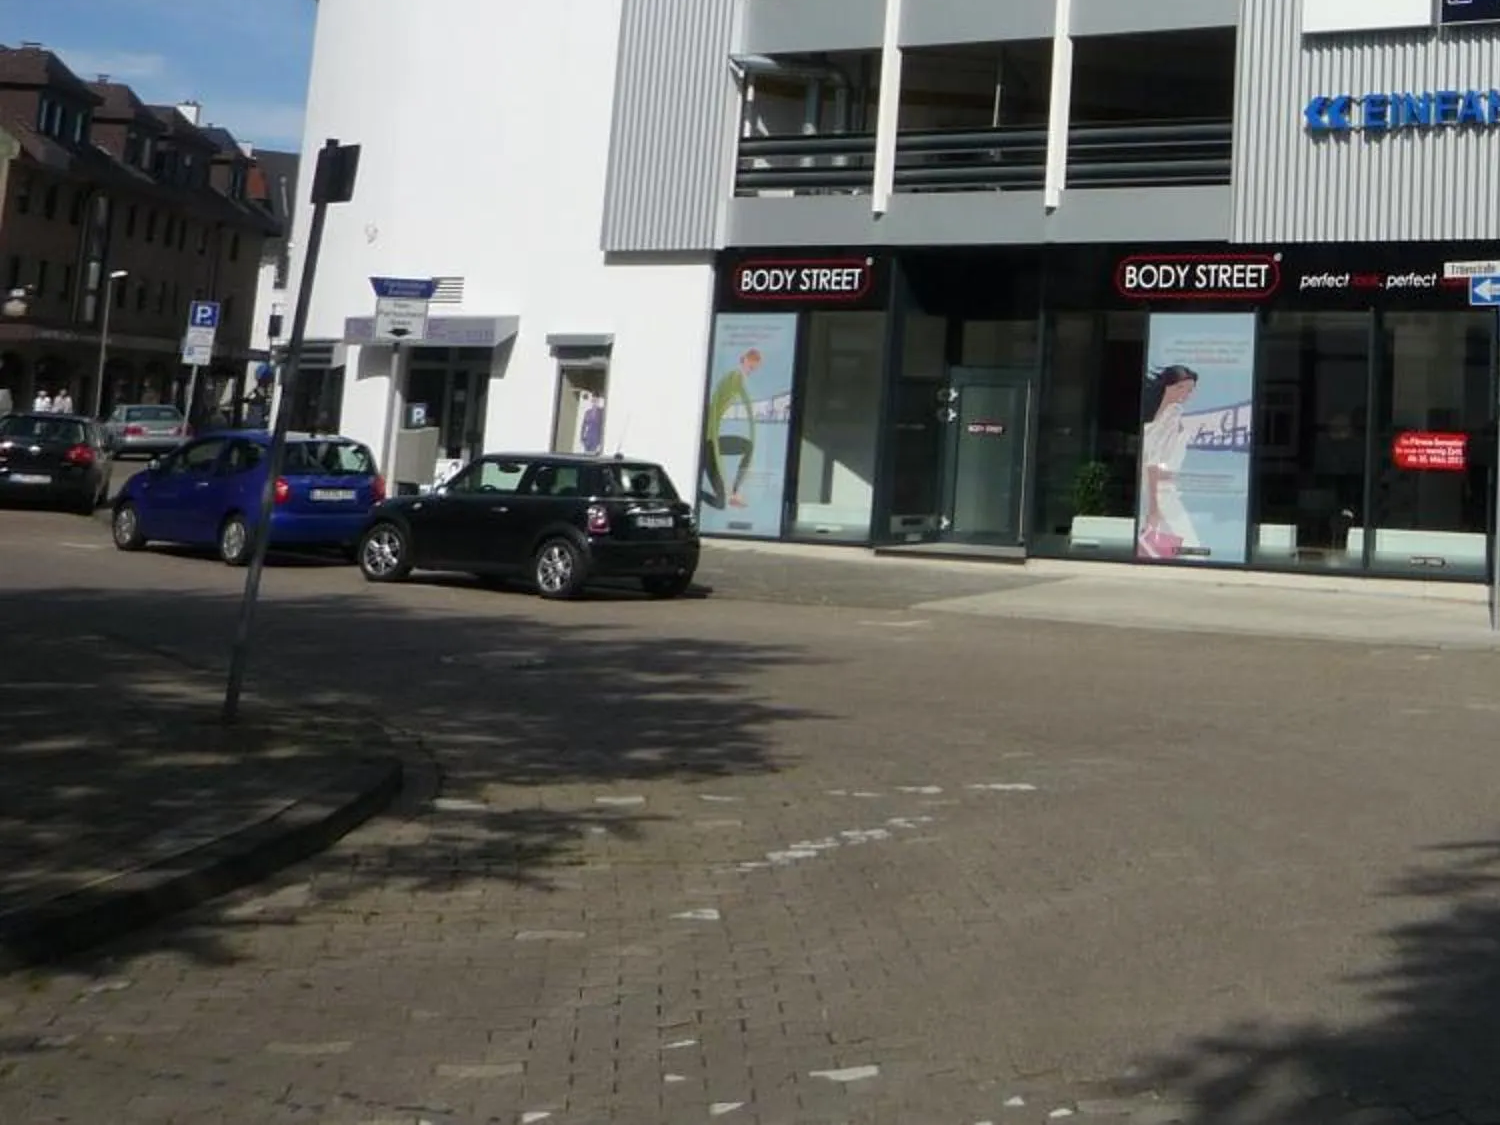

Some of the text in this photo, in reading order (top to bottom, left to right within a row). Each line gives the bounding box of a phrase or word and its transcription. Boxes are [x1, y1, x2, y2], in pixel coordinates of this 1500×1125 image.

[741, 268, 863, 291] BODY STREET
[1125, 264, 1269, 288] BODY STREET
[1299, 272, 1350, 291] perfect
[1386, 272, 1437, 290] perfect
